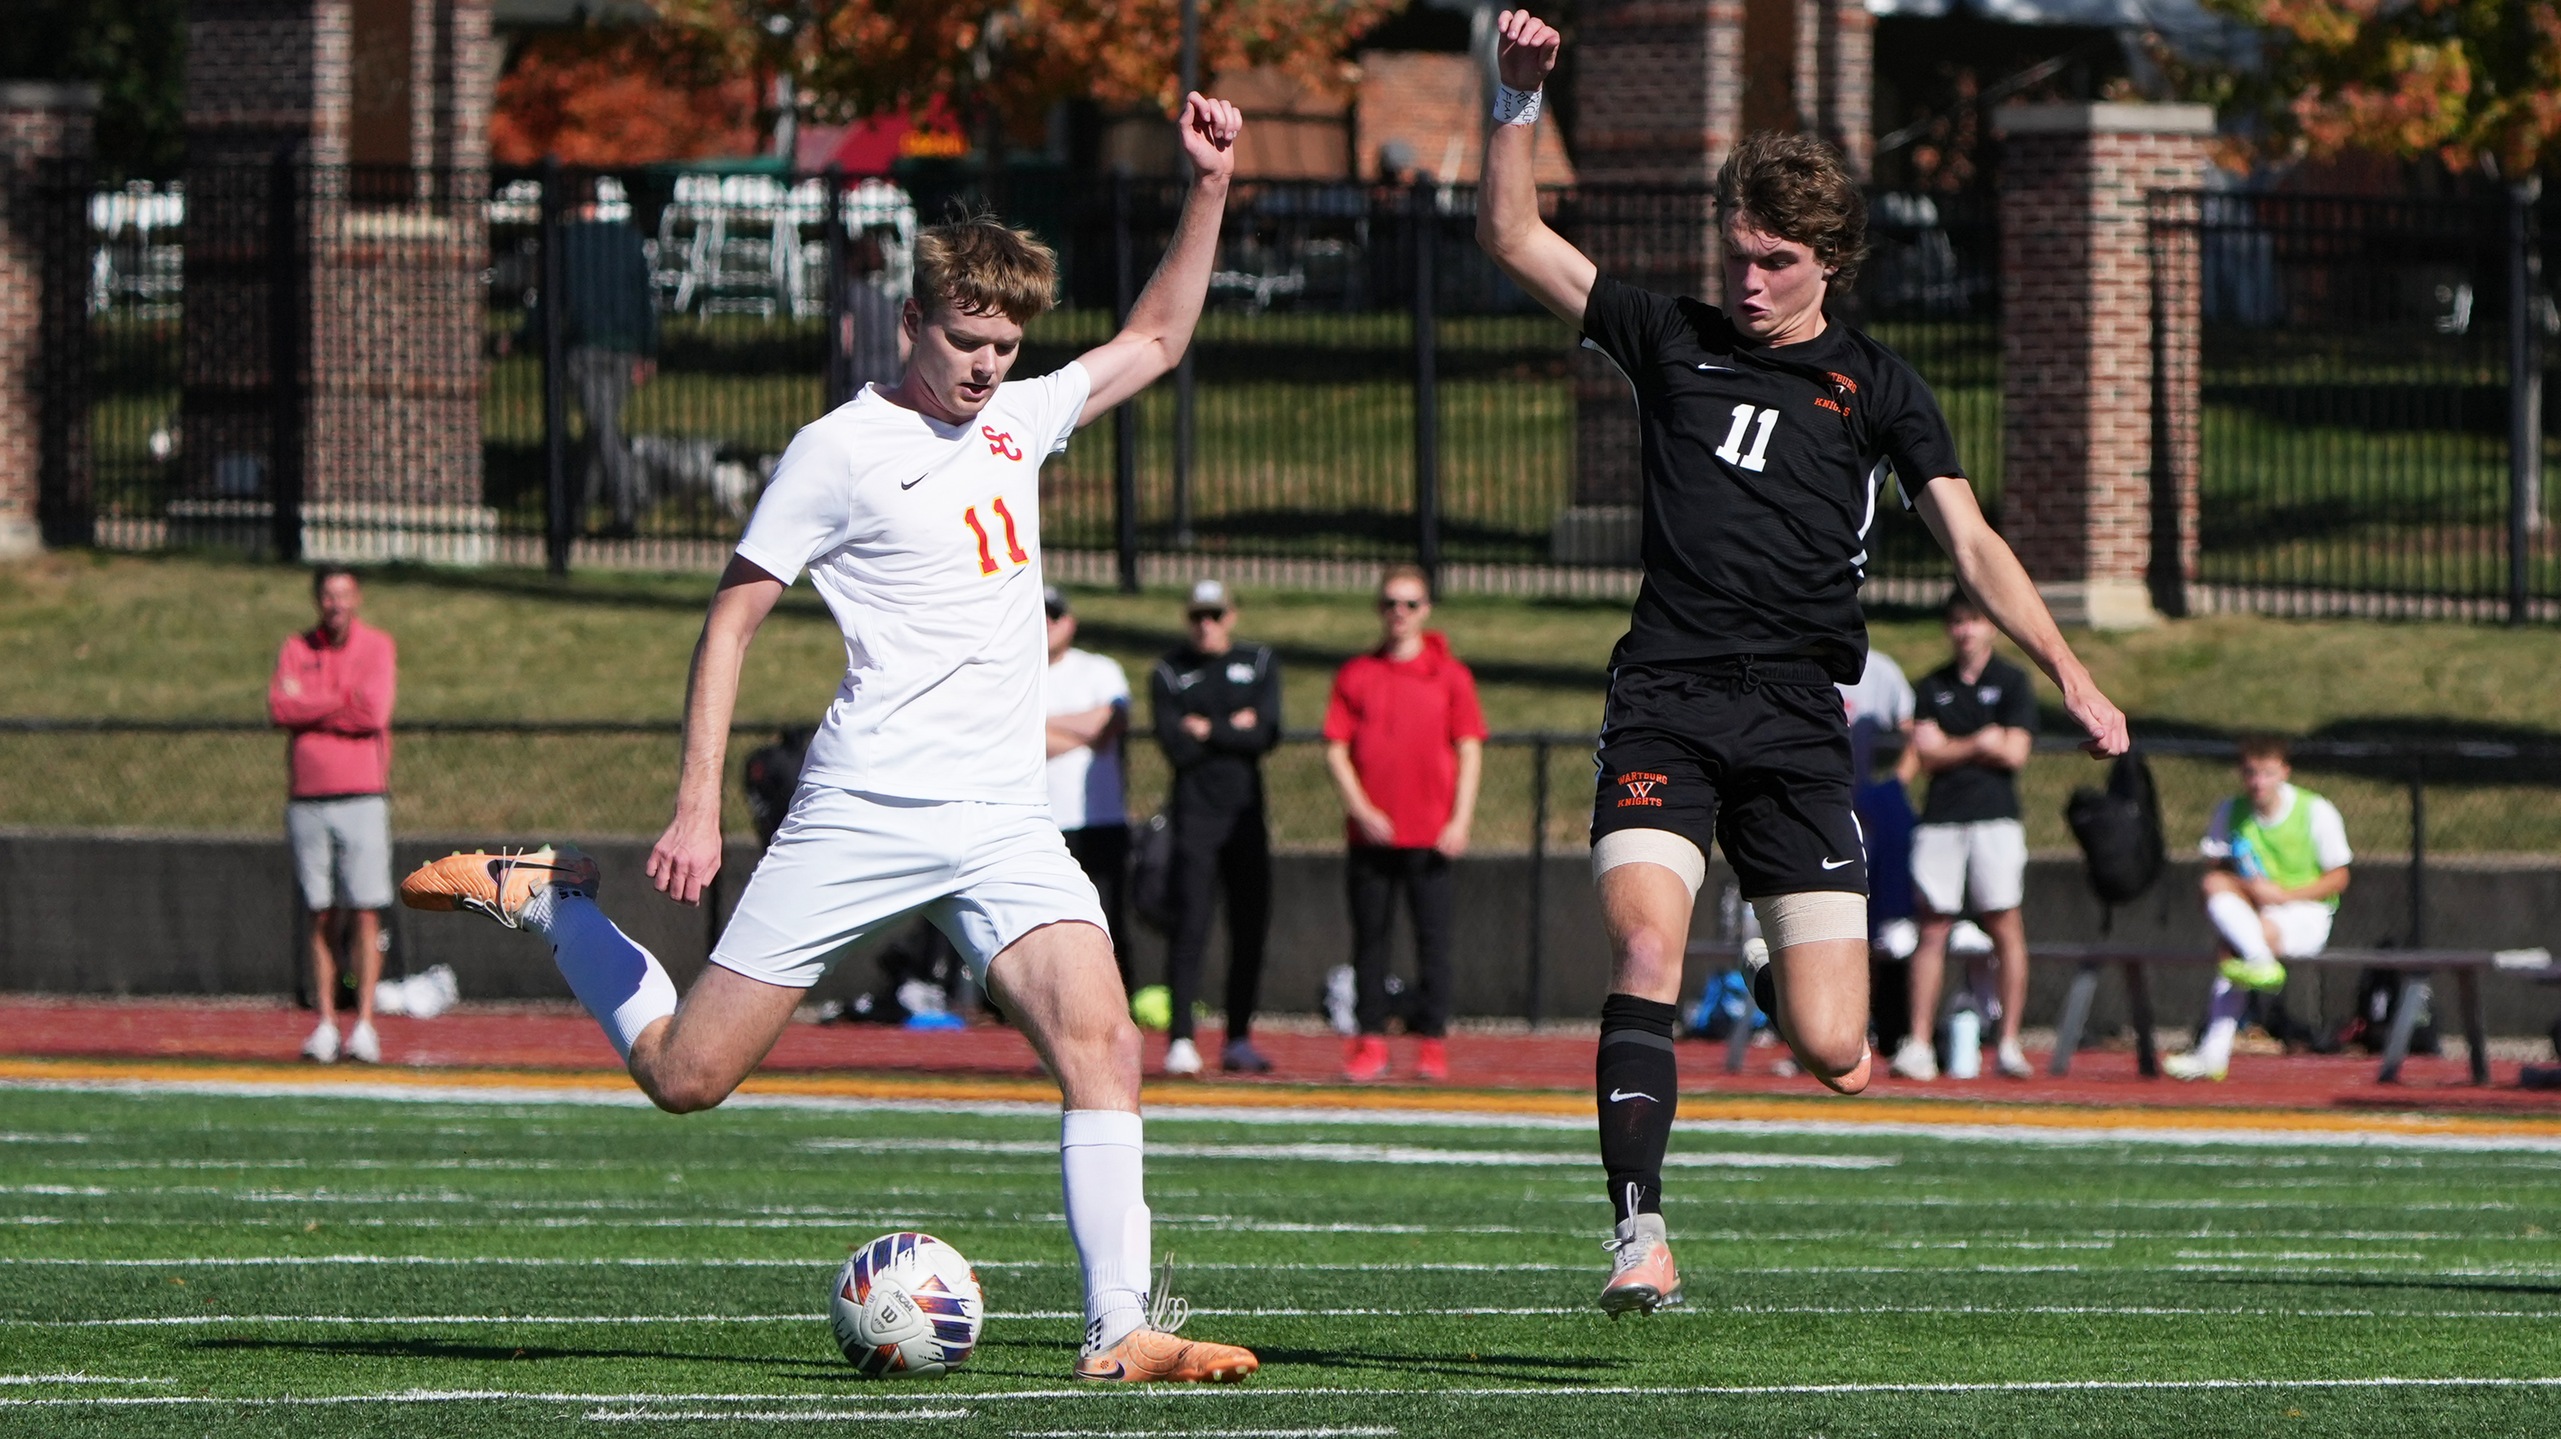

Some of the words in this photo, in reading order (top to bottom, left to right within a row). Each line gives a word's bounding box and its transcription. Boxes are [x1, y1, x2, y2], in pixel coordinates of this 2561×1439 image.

[1814, 398, 1851, 417] KNIGS
[981, 425, 1022, 461] SC
[1715, 403, 1780, 472] 11
[964, 496, 1029, 577] 11
[1617, 771, 1668, 785] WARTBURG
[1626, 781, 1656, 798] W
[1617, 797, 1663, 807] KNIGHTS
[893, 1290, 915, 1312] NCAA
